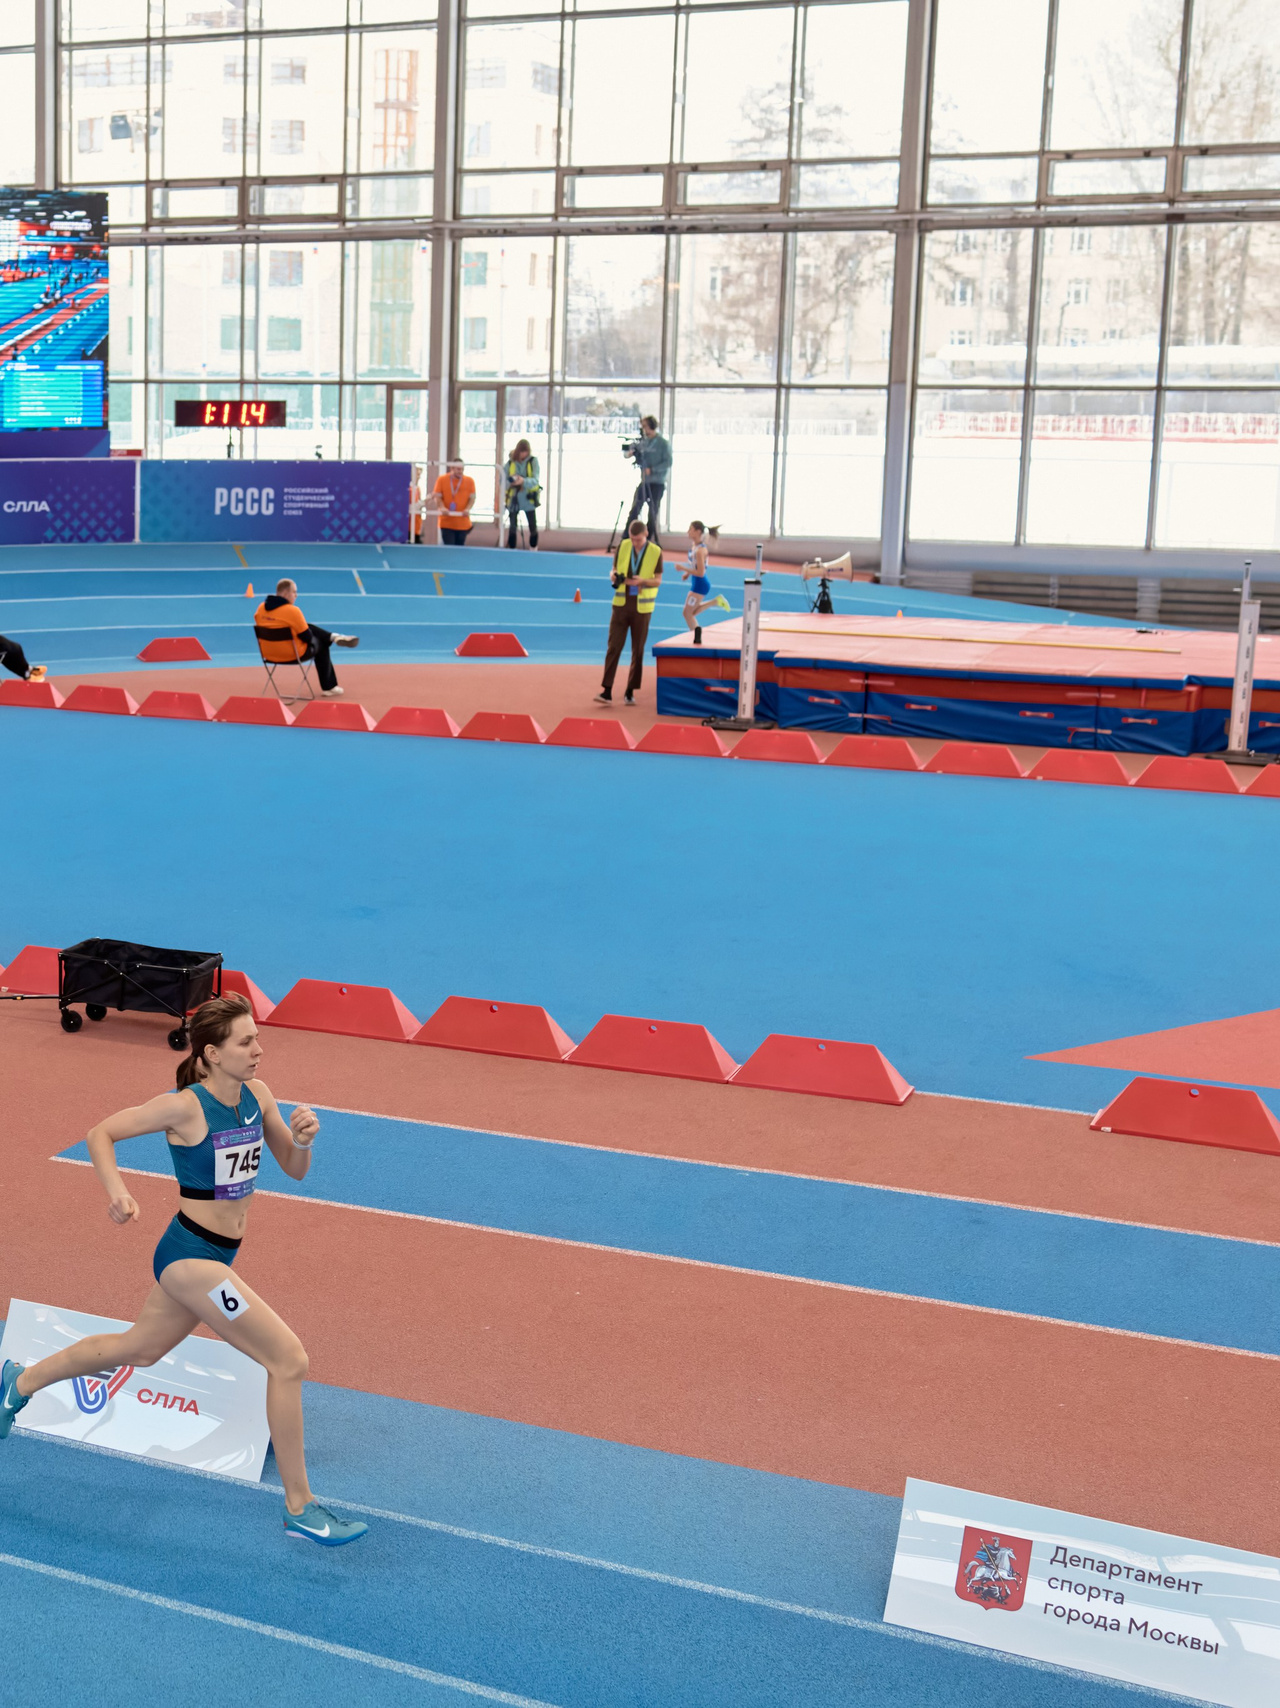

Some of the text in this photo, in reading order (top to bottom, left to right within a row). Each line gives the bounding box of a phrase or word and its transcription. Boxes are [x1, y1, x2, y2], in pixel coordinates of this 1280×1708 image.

[3, 500, 51, 513] СЛЛА
[214, 487, 275, 516] РССС
[225, 1146, 261, 1179] 745
[221, 1290, 239, 1312] 6
[136, 1388, 200, 1416] СЛЛА
[1050, 1546, 1203, 1595] Департамент
[1047, 1576, 1125, 1606] спорта
[1043, 1601, 1219, 1656] города Москвы
